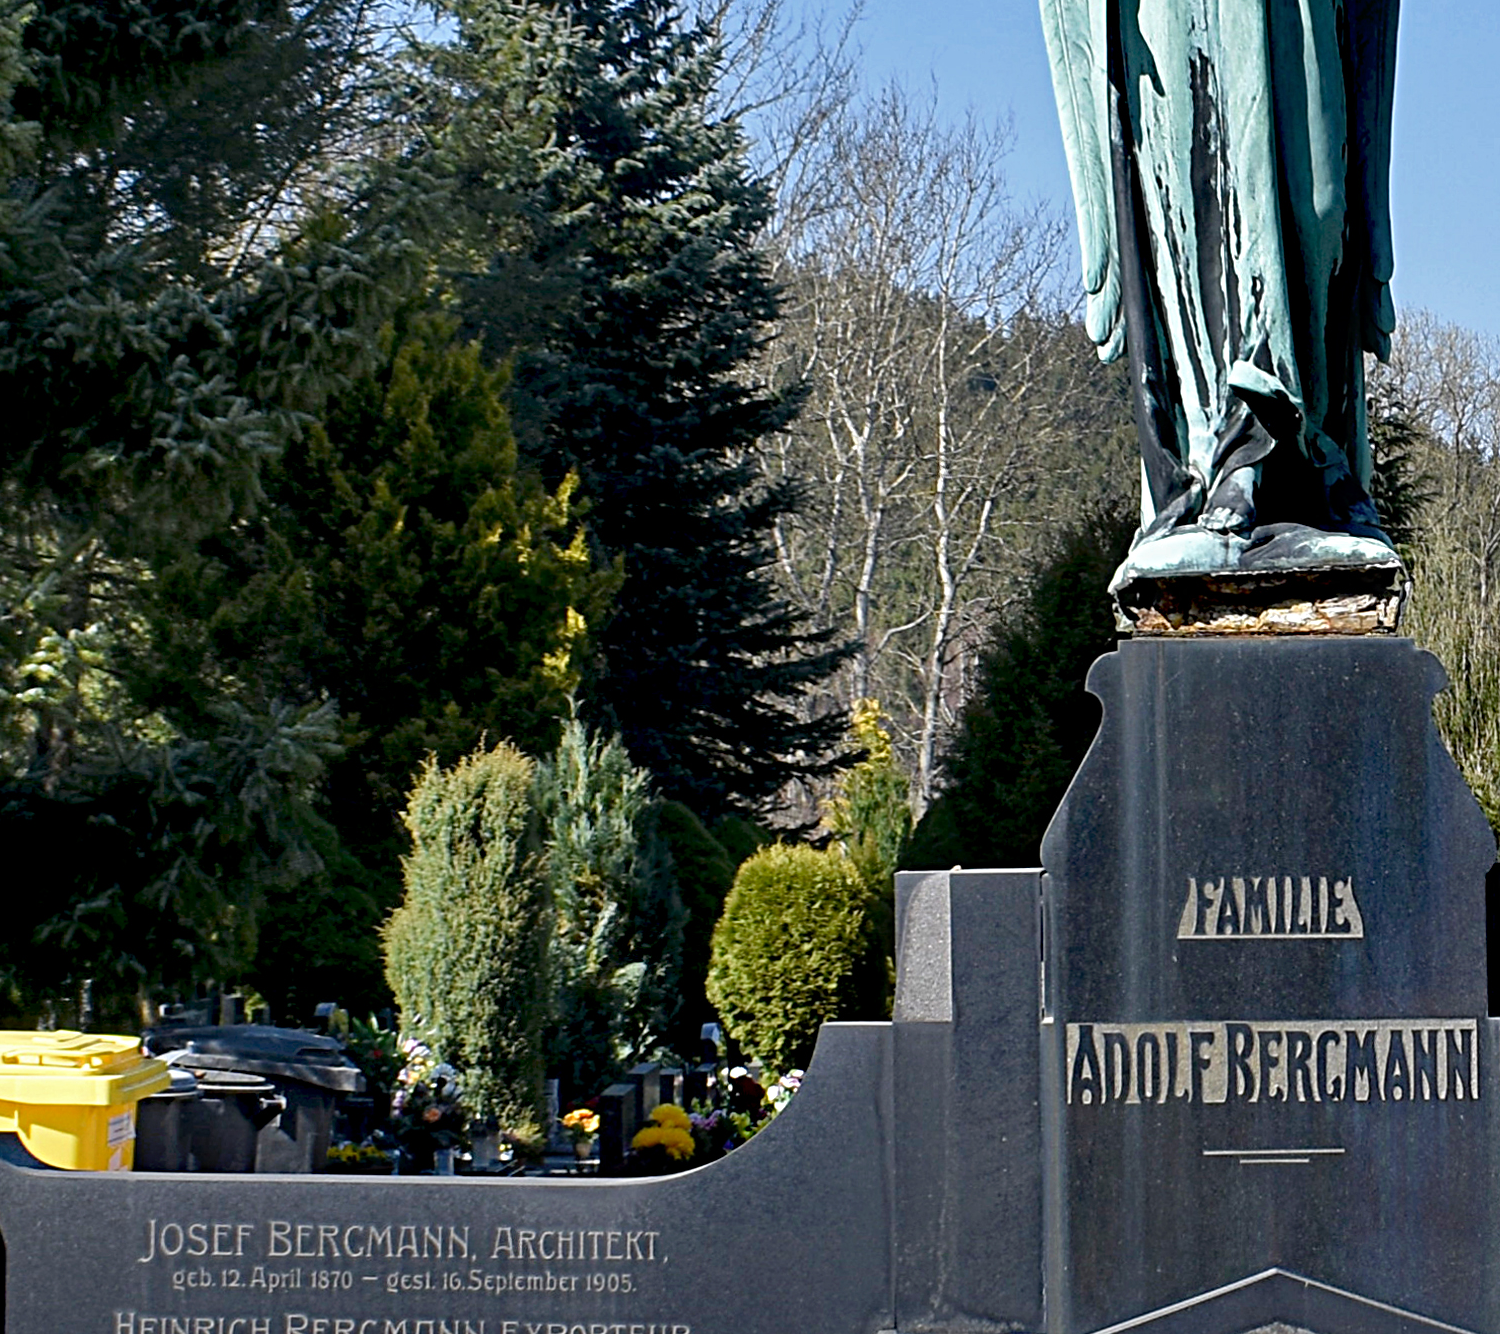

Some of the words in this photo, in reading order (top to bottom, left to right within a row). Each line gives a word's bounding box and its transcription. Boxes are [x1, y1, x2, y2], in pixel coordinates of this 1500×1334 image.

[1183, 876, 1361, 938] FAMILIE
[1068, 1021, 1217, 1104] ADOLF
[1222, 1019, 1479, 1103] BERGMANN
[137, 1218, 255, 1264] JOSEF
[171, 1266, 216, 1292] geb.
[249, 1265, 301, 1294] April
[311, 1269, 353, 1290] 1870
[586, 1271, 637, 1294] 1905.
